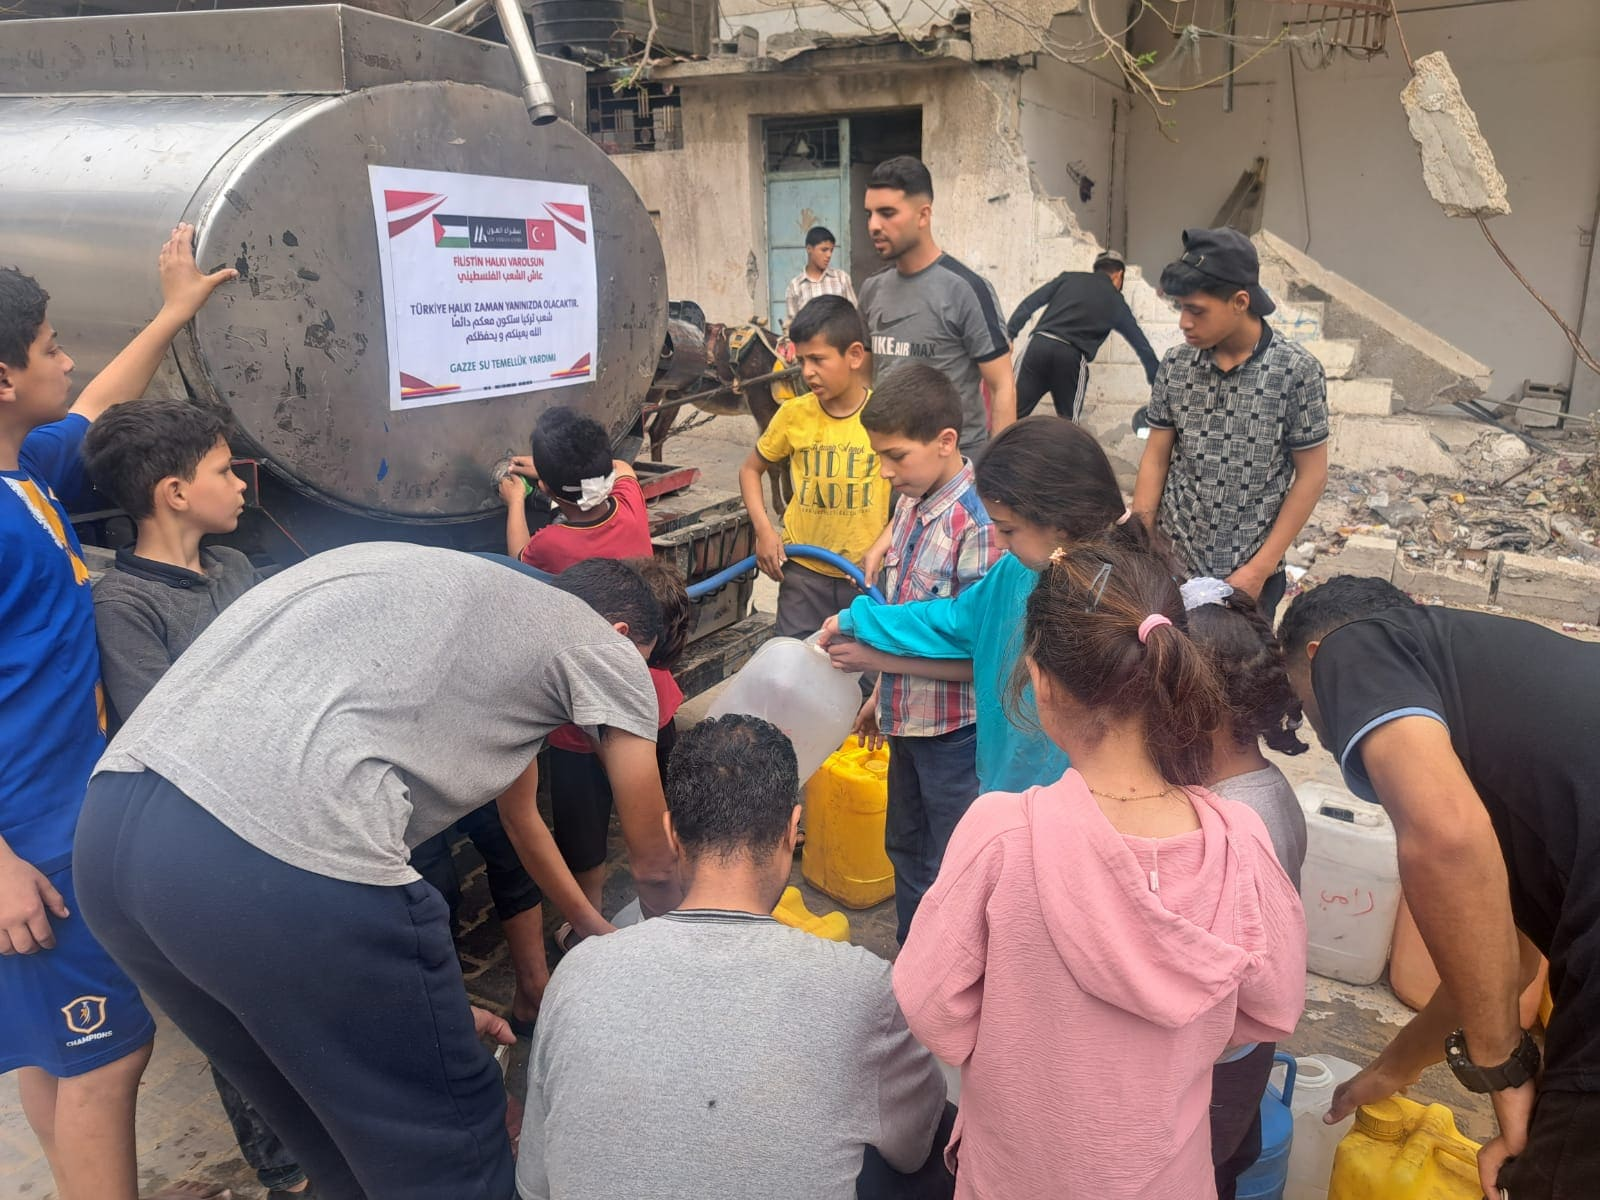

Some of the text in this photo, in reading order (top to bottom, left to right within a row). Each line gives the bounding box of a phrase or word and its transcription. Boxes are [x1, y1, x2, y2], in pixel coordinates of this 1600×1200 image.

[485, 256, 507, 267] HALKI
[509, 256, 544, 267] VAROLSUN
[457, 269, 544, 283] عاش الشعب الفلسطيني
[410, 302, 447, 315] TÜRKİYE
[448, 303, 472, 313] HALKI
[474, 302, 504, 312] ZAMAN
[505, 300, 543, 311] YANINIZDA
[472, 316, 495, 329] معكم
[496, 315, 520, 327] ستكون
[521, 313, 535, 325] تركيا
[536, 312, 553, 324] شعب
[466, 331, 498, 344] يحفظكم
[499, 332, 504, 342] و
[529, 327, 542, 336] الله
[871, 336, 936, 357] IKE AIR MAX
[450, 353, 557, 373] GAZZE SU TEMELLÜK YARDIMI
[65, 1030, 113, 1047] CHAMPIONS
